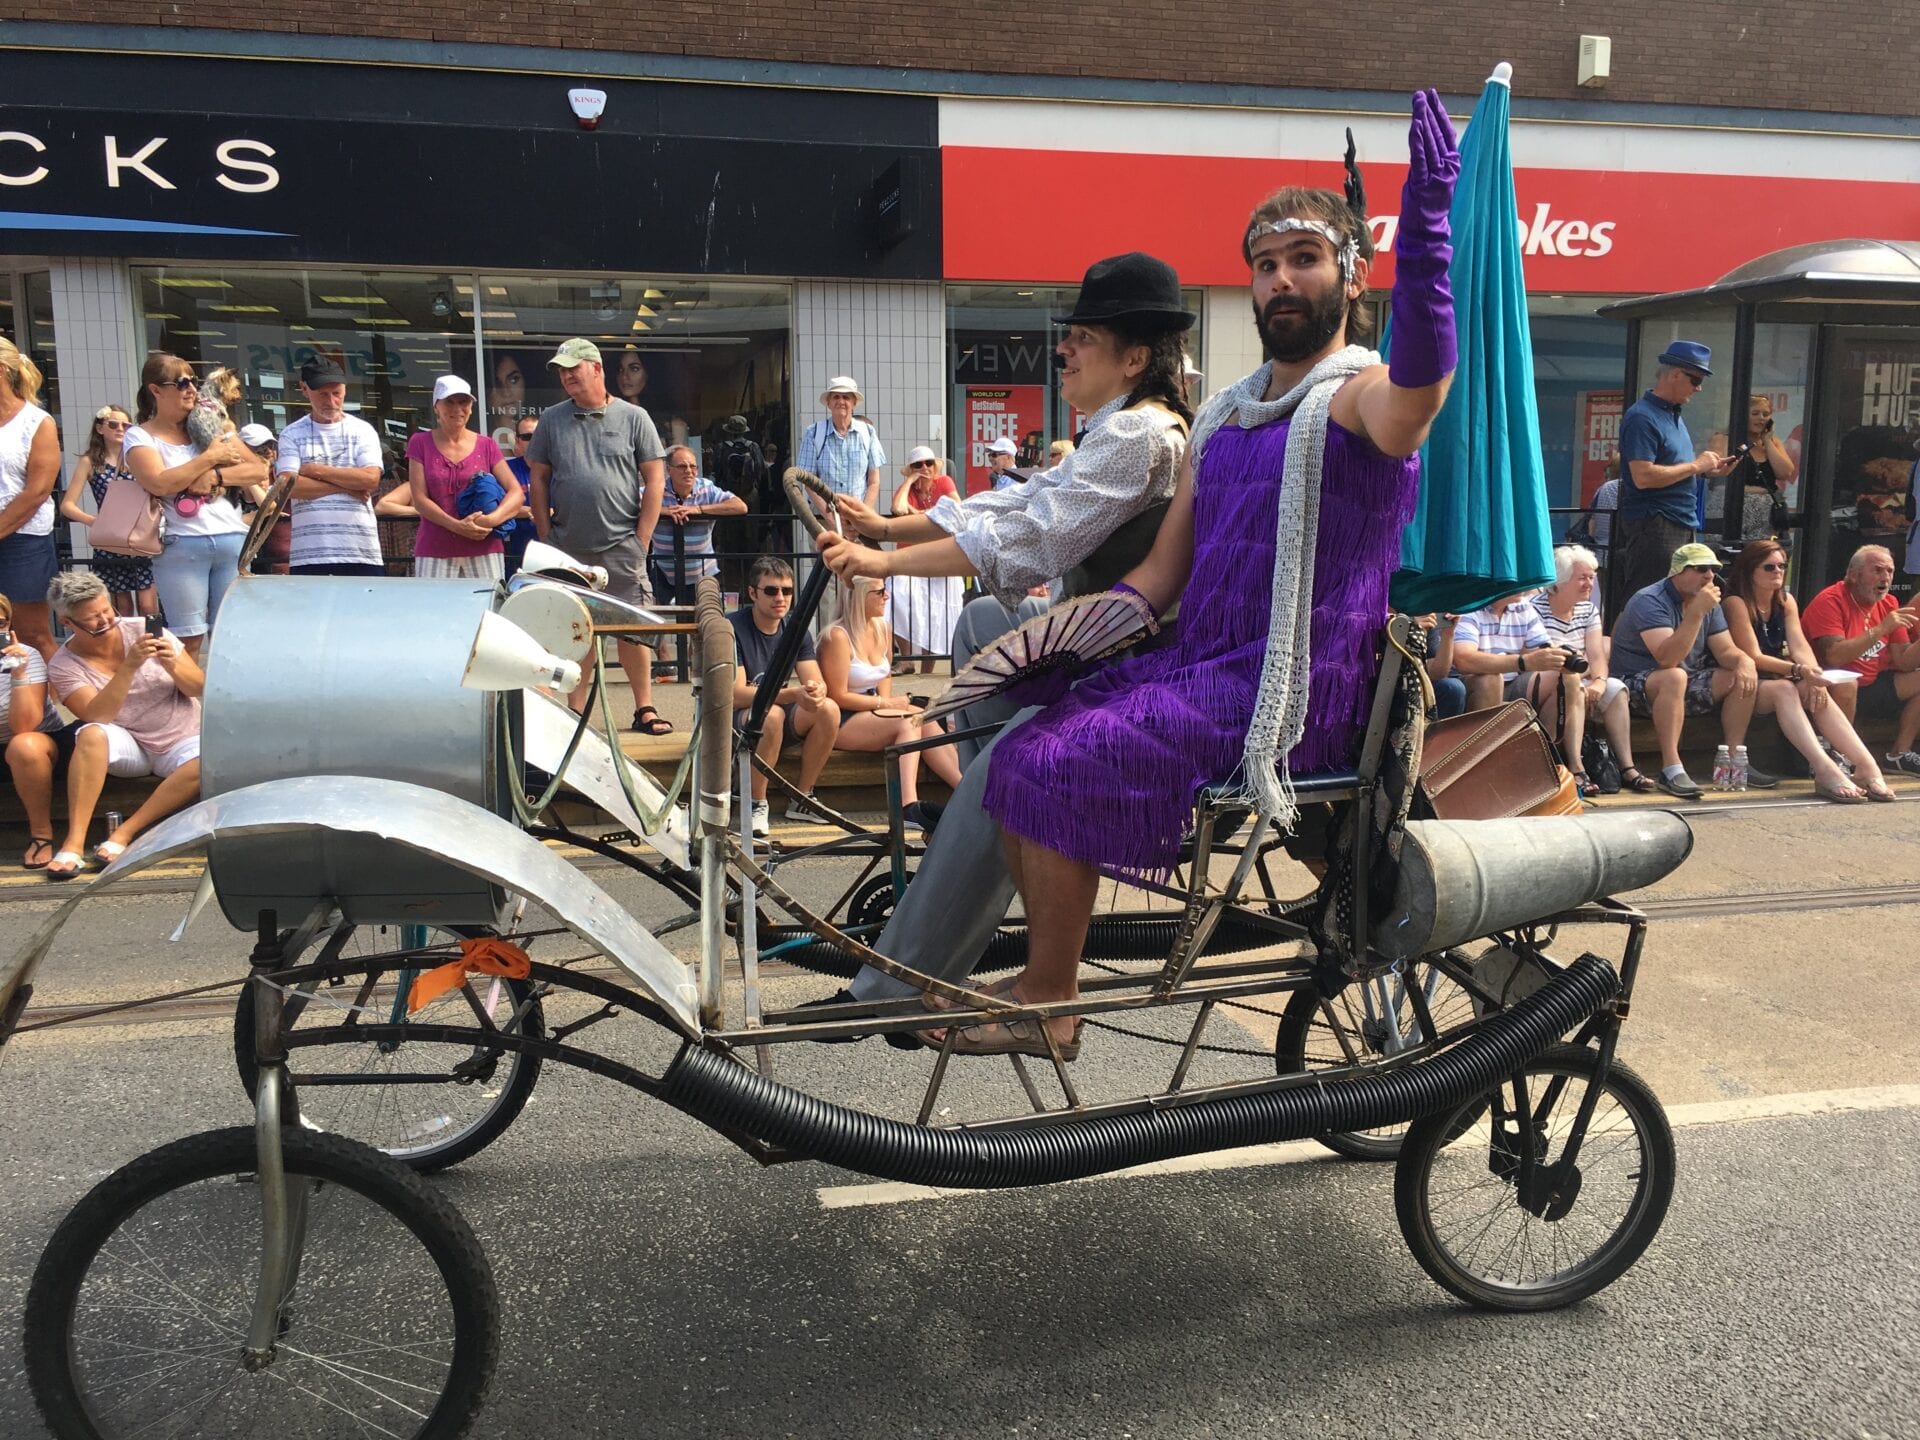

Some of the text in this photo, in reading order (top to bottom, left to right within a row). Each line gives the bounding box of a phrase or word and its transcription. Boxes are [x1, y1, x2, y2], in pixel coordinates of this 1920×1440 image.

[574, 96, 602, 105] KINGS
[0, 131, 280, 193] CKS
[972, 413, 1018, 441] FREE
